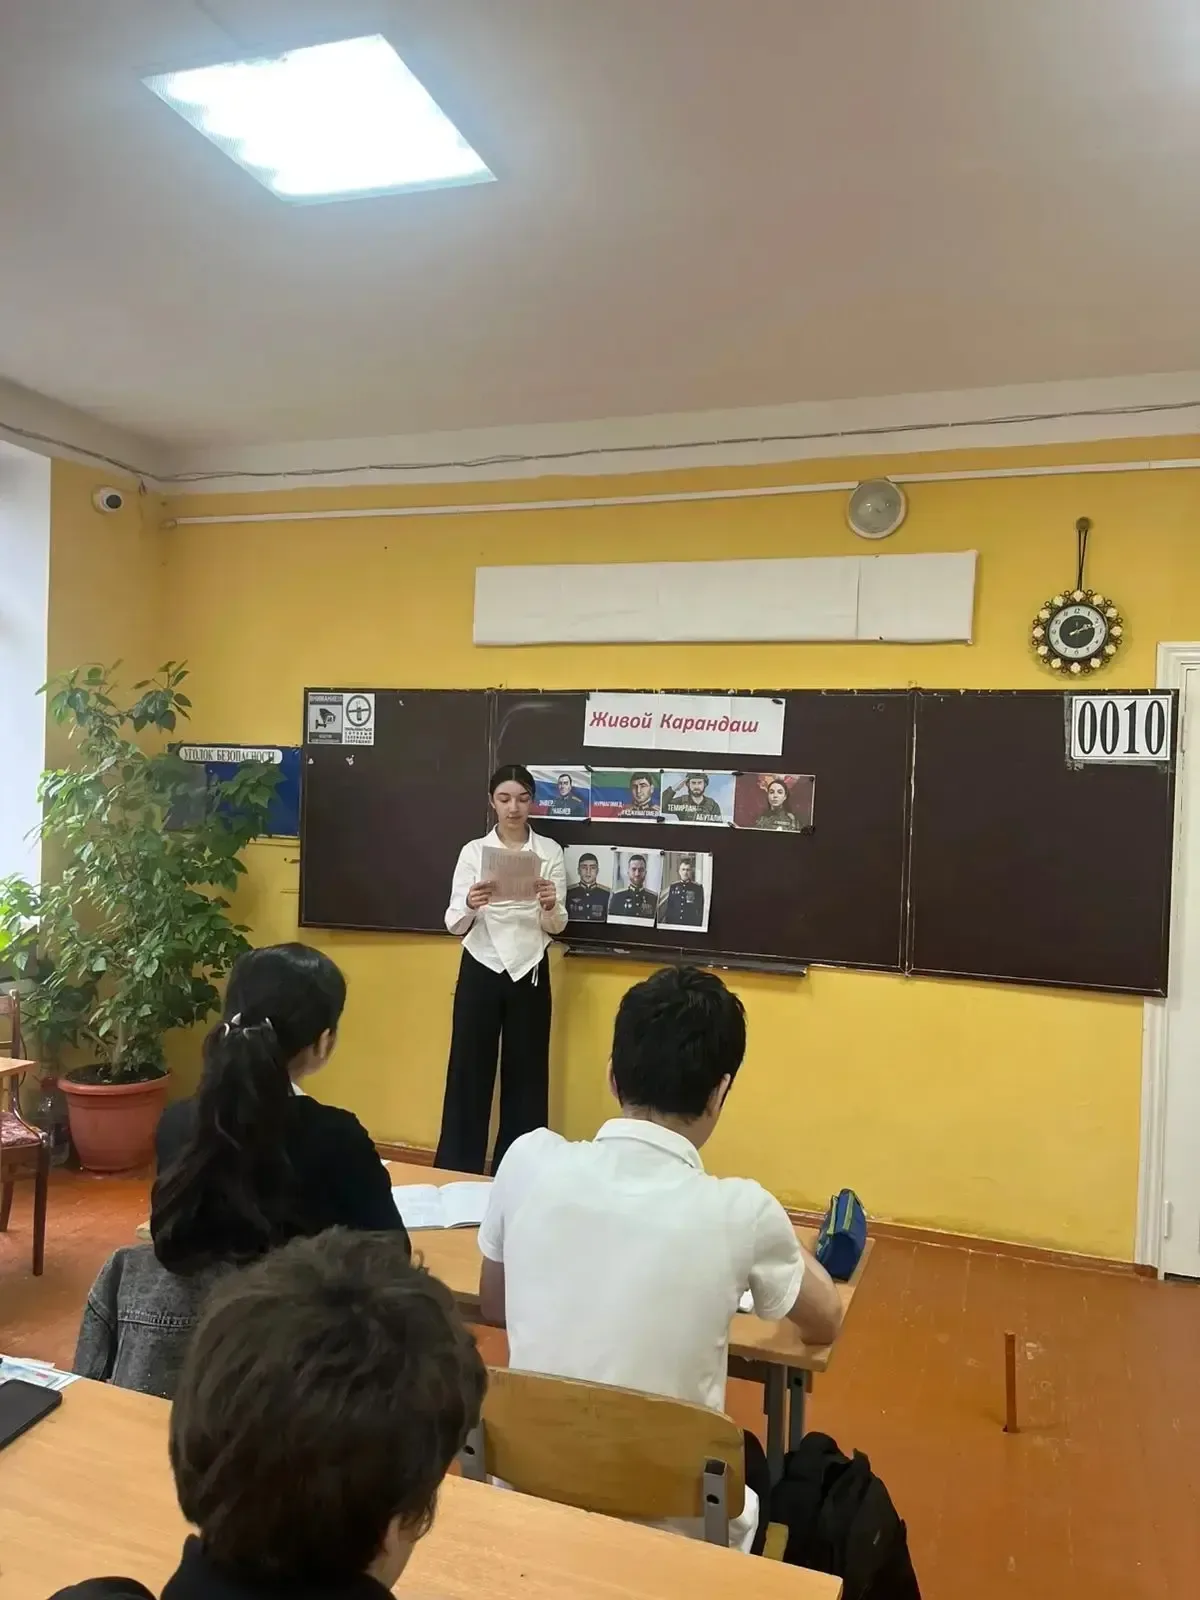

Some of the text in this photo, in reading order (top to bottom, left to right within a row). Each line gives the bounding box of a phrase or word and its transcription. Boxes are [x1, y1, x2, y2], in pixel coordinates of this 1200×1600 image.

[589, 711, 760, 733] Живой Карандаш
[1077, 700, 1165, 755] 0010
[184, 748, 214, 761] УГОЛОК
